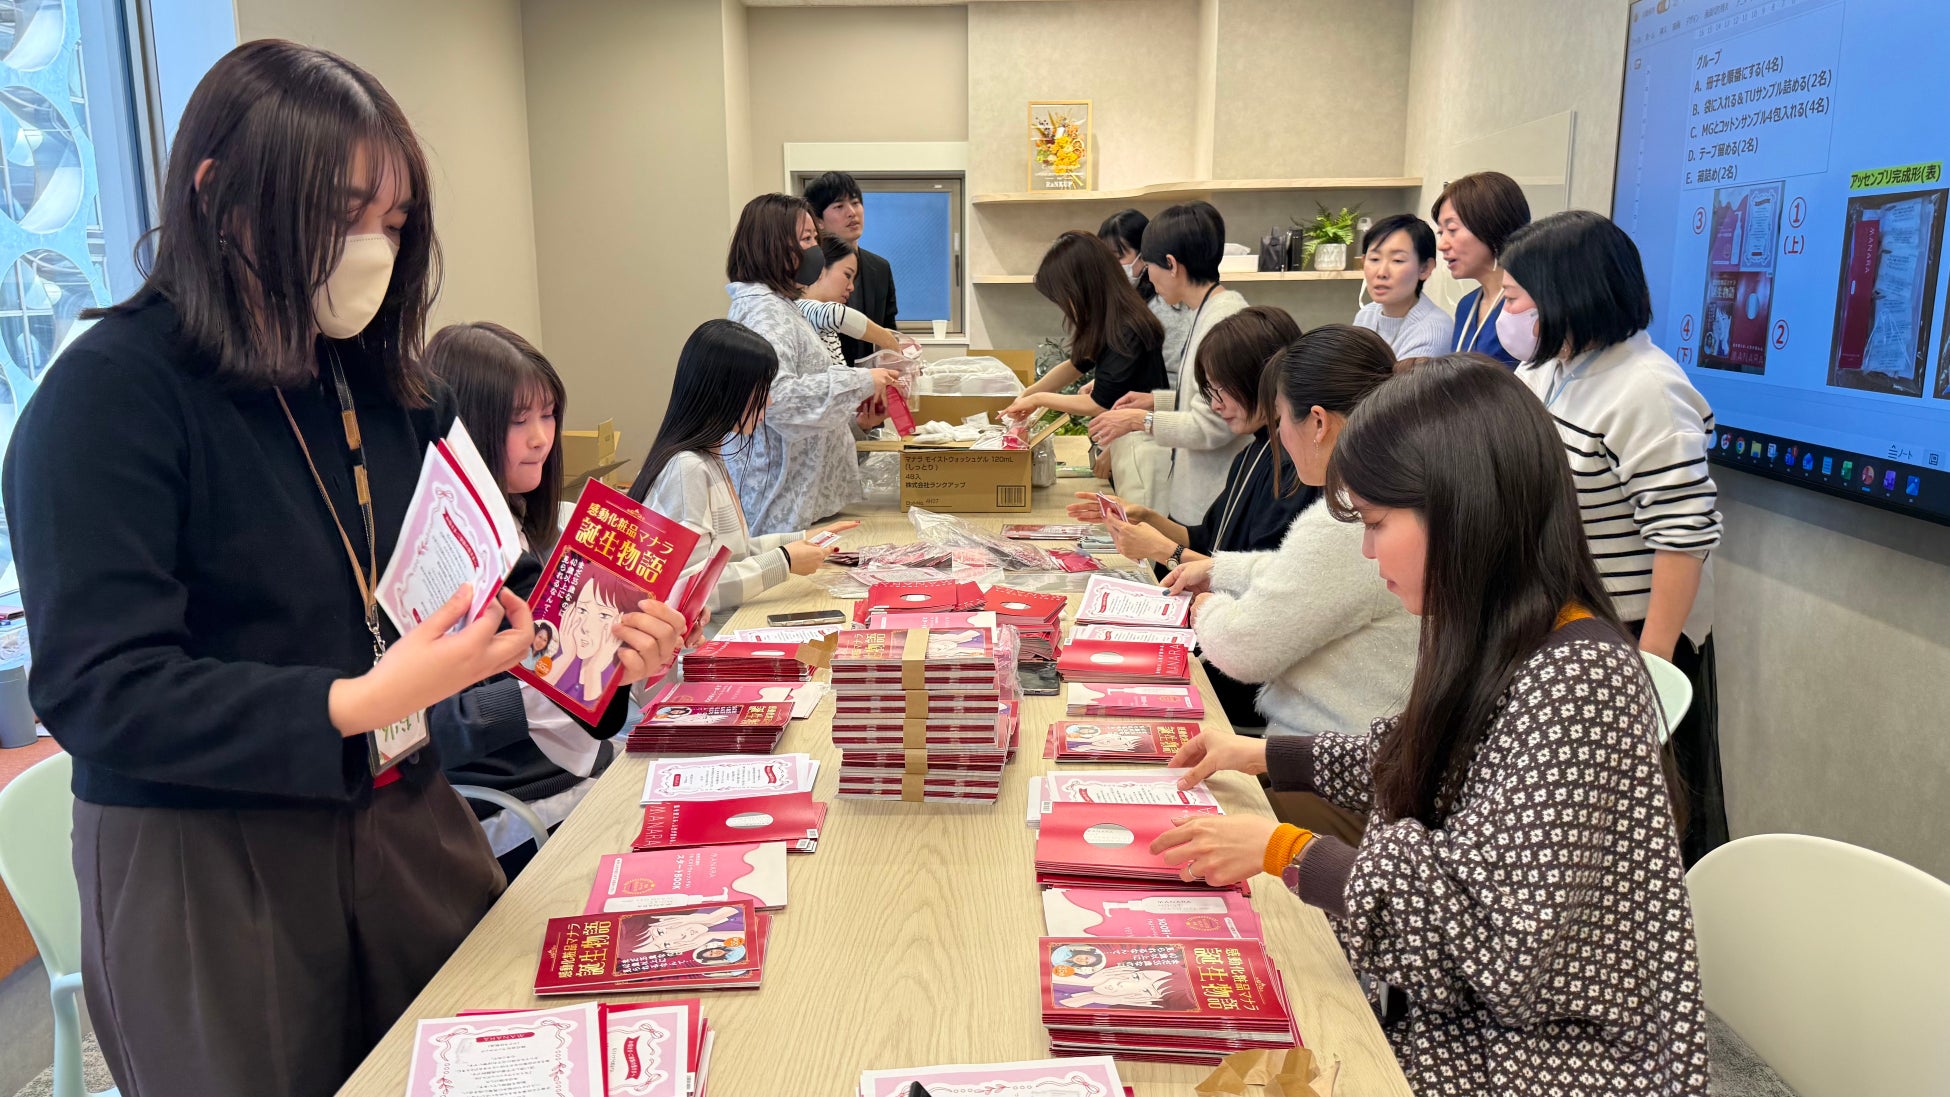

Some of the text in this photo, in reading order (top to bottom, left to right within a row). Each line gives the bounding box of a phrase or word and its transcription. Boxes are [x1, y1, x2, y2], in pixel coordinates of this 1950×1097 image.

[1696, 49, 1722, 70] グループ
[1694, 80, 1702, 93] A.
[1692, 104, 1700, 116] B.
[1690, 126, 1697, 138] C.
[1688, 137, 1759, 162] D. テープ留める(2名)
[1686, 172, 1692, 184] E.
[1851, 165, 1941, 188] アッセンブリ完成形(表)
[1784, 235, 1804, 254] (上)
[587, 502, 674, 555] 感動化粧品マナラ
[575, 517, 667, 583] 誕生物語
[645, 805, 666, 847] MANARA
[672, 854, 685, 890] スタートBOOK
[558, 923, 581, 978] 感動化粧品マナラ
[576, 921, 612, 978] 誕生物語
[1194, 947, 1241, 1011] 誕生物語
[1225, 948, 1259, 1011] 感動化粧品マナラ
